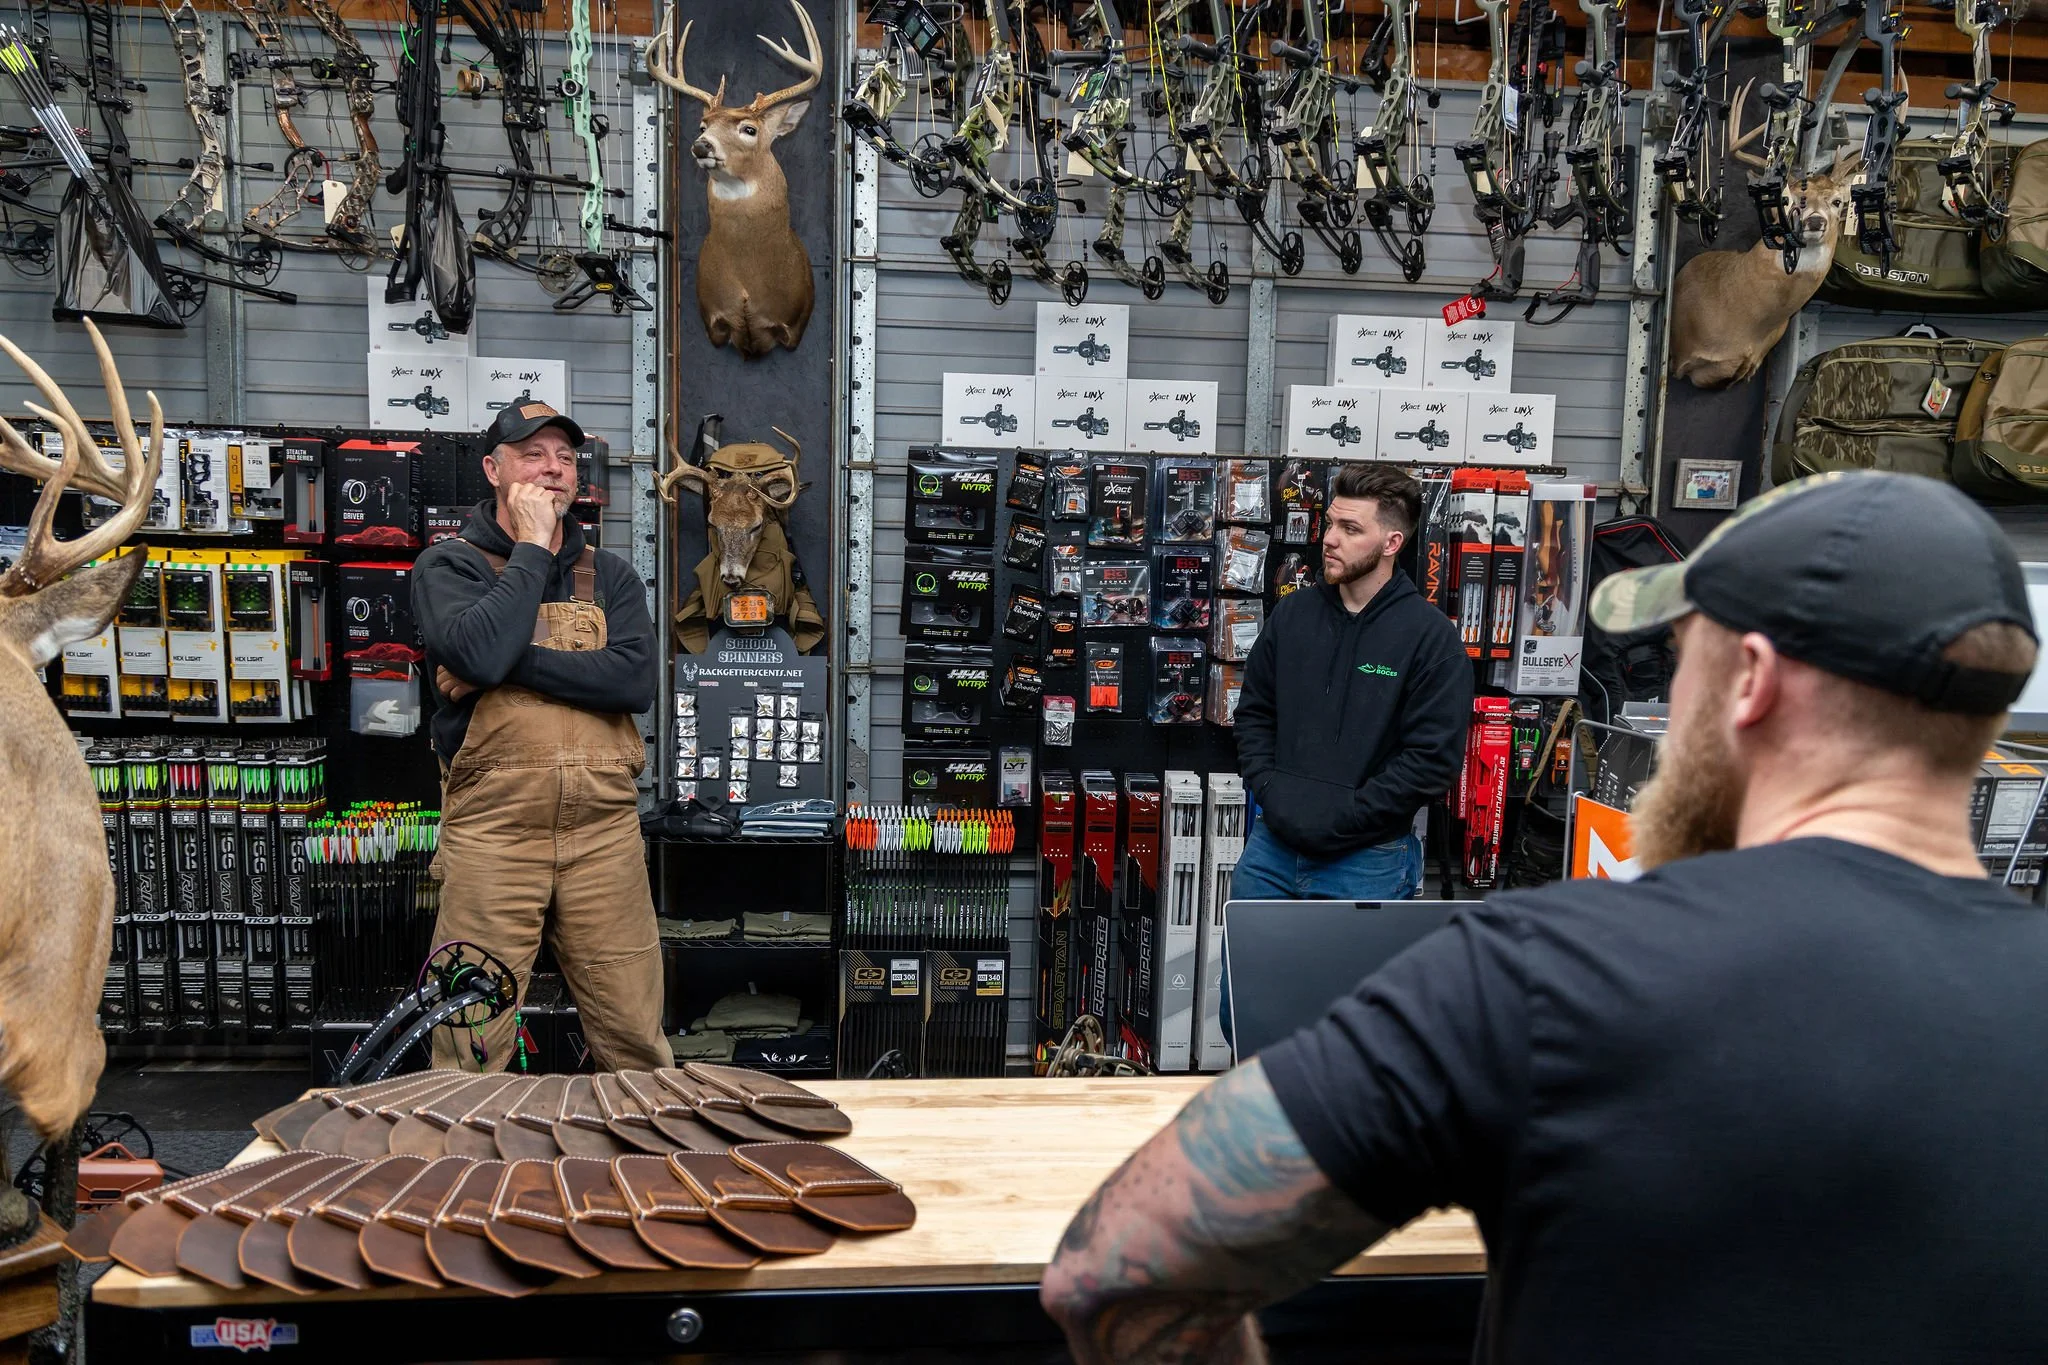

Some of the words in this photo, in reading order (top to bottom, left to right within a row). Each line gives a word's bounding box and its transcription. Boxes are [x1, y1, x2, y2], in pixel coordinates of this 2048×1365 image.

[1872, 268, 1929, 284] ESTON
[1058, 314, 1079, 325] eXact
[1085, 316, 1107, 327] LINX
[1357, 327, 1378, 338] eXact
[1383, 329, 1404, 341] LINX
[1447, 331, 1467, 341] eXact
[1472, 331, 1493, 342] LINX
[391, 366, 413, 379] eXact
[420, 367, 444, 379] LINX
[490, 370, 512, 381] eXact
[519, 371, 541, 383] LINX
[965, 385, 986, 396] eXact
[992, 386, 1013, 397] LINX
[1057, 388, 1078, 400] eXact
[1084, 390, 1105, 400] LINX
[1149, 391, 1170, 402] eXact
[1175, 392, 1197, 404] LINX
[1311, 397, 1332, 408] eXact
[1337, 398, 1358, 410] LINX
[1400, 401, 1420, 412] eXact
[1426, 402, 1446, 413] LINX
[1488, 404, 1508, 414] eXact
[1514, 405, 1534, 416] LINX
[1104, 482, 1132, 497] eXact
[343, 512, 364, 520] DRIVER
[1426, 542, 1440, 605] RAVIN
[725, 638, 776, 650] SCHOOL
[718, 650, 783, 663] SPINNERS
[699, 668, 803, 677] RACKGETTERSCENTS.NET
[1495, 768, 1505, 818] HYPERFLITE
[1492, 820, 1500, 844] LIGHTED
[139, 874, 153, 913] RIP
[181, 874, 195, 912] RIP
[220, 873, 232, 912] VAP
[251, 877, 263, 917] VAP
[290, 877, 302, 917] VAP
[1093, 916, 1108, 1017] RAMPAGE
[1053, 931, 1067, 1029] SPARTAN
[414, 996, 473, 1038] TITLE
[221, 1323, 268, 1341] USA
